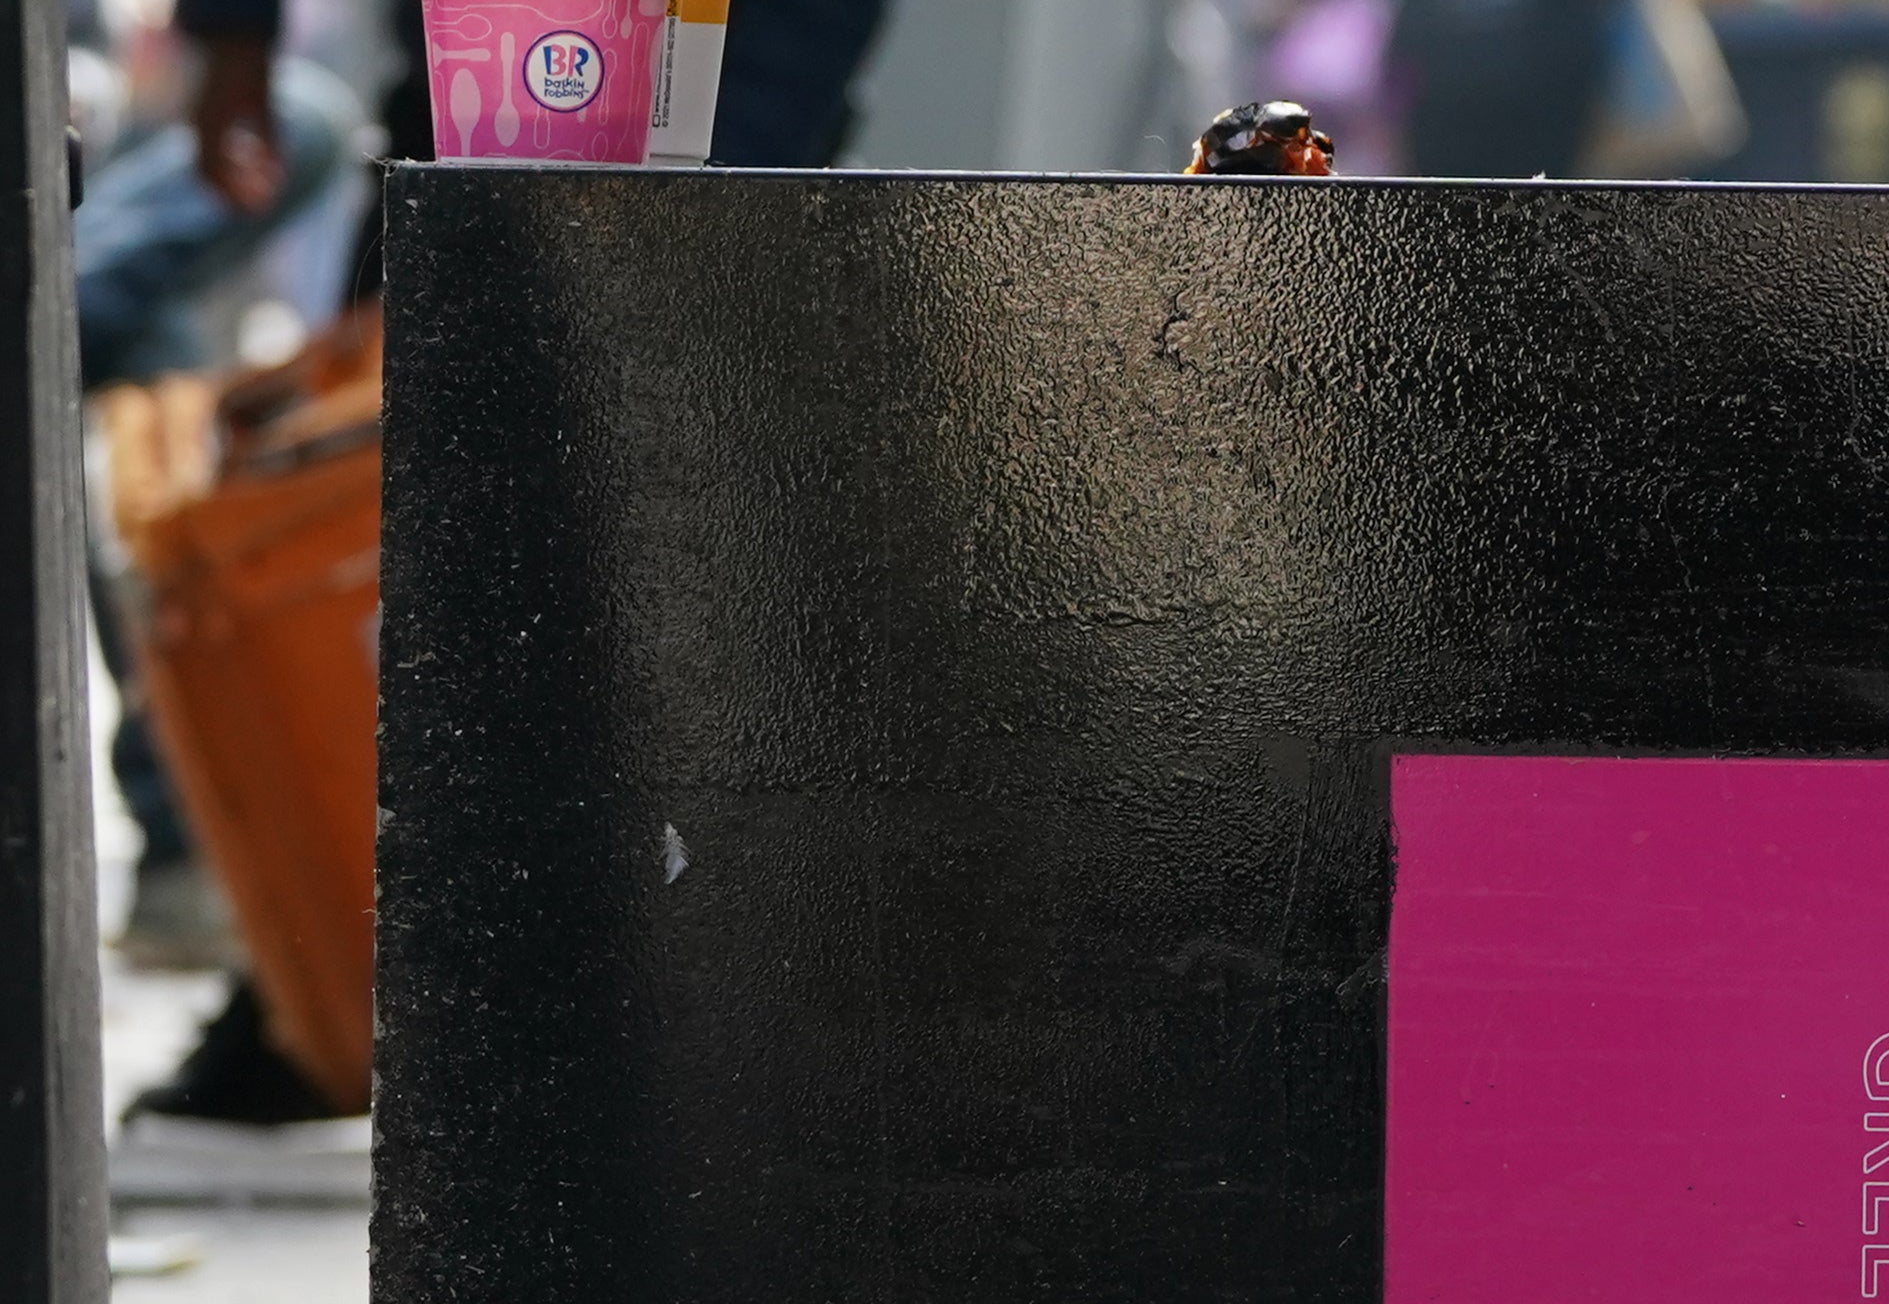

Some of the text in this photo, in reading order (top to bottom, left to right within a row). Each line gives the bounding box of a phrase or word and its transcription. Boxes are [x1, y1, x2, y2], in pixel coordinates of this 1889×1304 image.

[544, 44, 590, 78] BR
[544, 76, 586, 90] baskin
[544, 87, 586, 99] robbins
